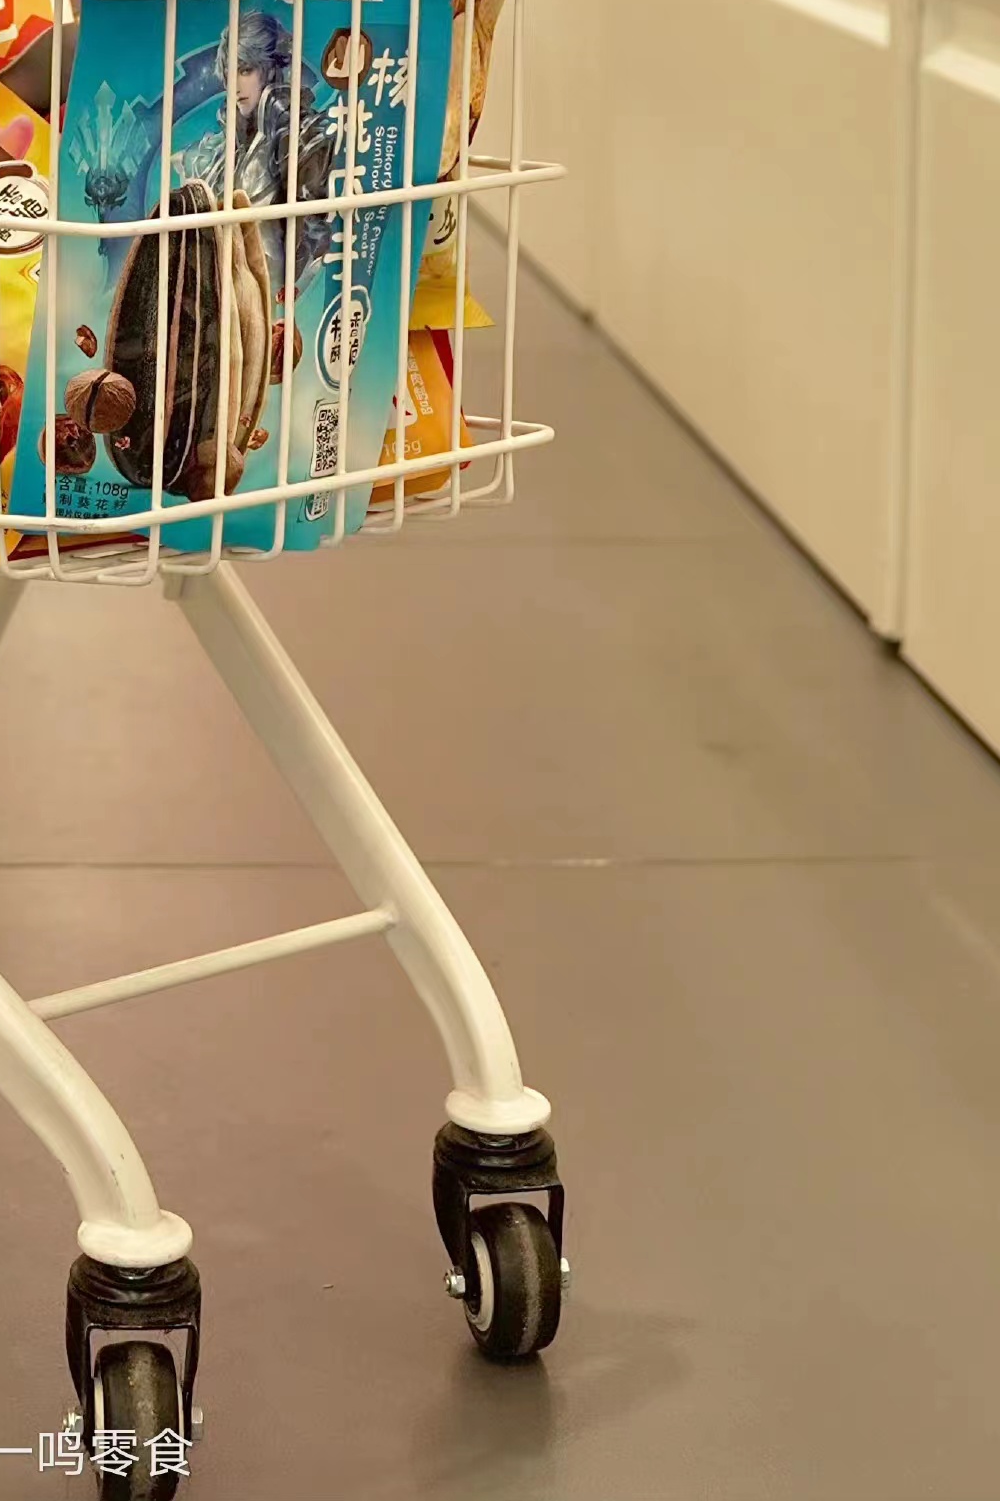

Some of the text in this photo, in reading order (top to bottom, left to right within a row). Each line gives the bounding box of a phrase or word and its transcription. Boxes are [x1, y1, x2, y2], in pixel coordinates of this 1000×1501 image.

[382, 126, 398, 190] Hickory
[360, 126, 386, 260] Sunflow Seeds
[42, 493, 127, 511] 制葵花籽
[45, 475, 129, 499] 含量:108g
